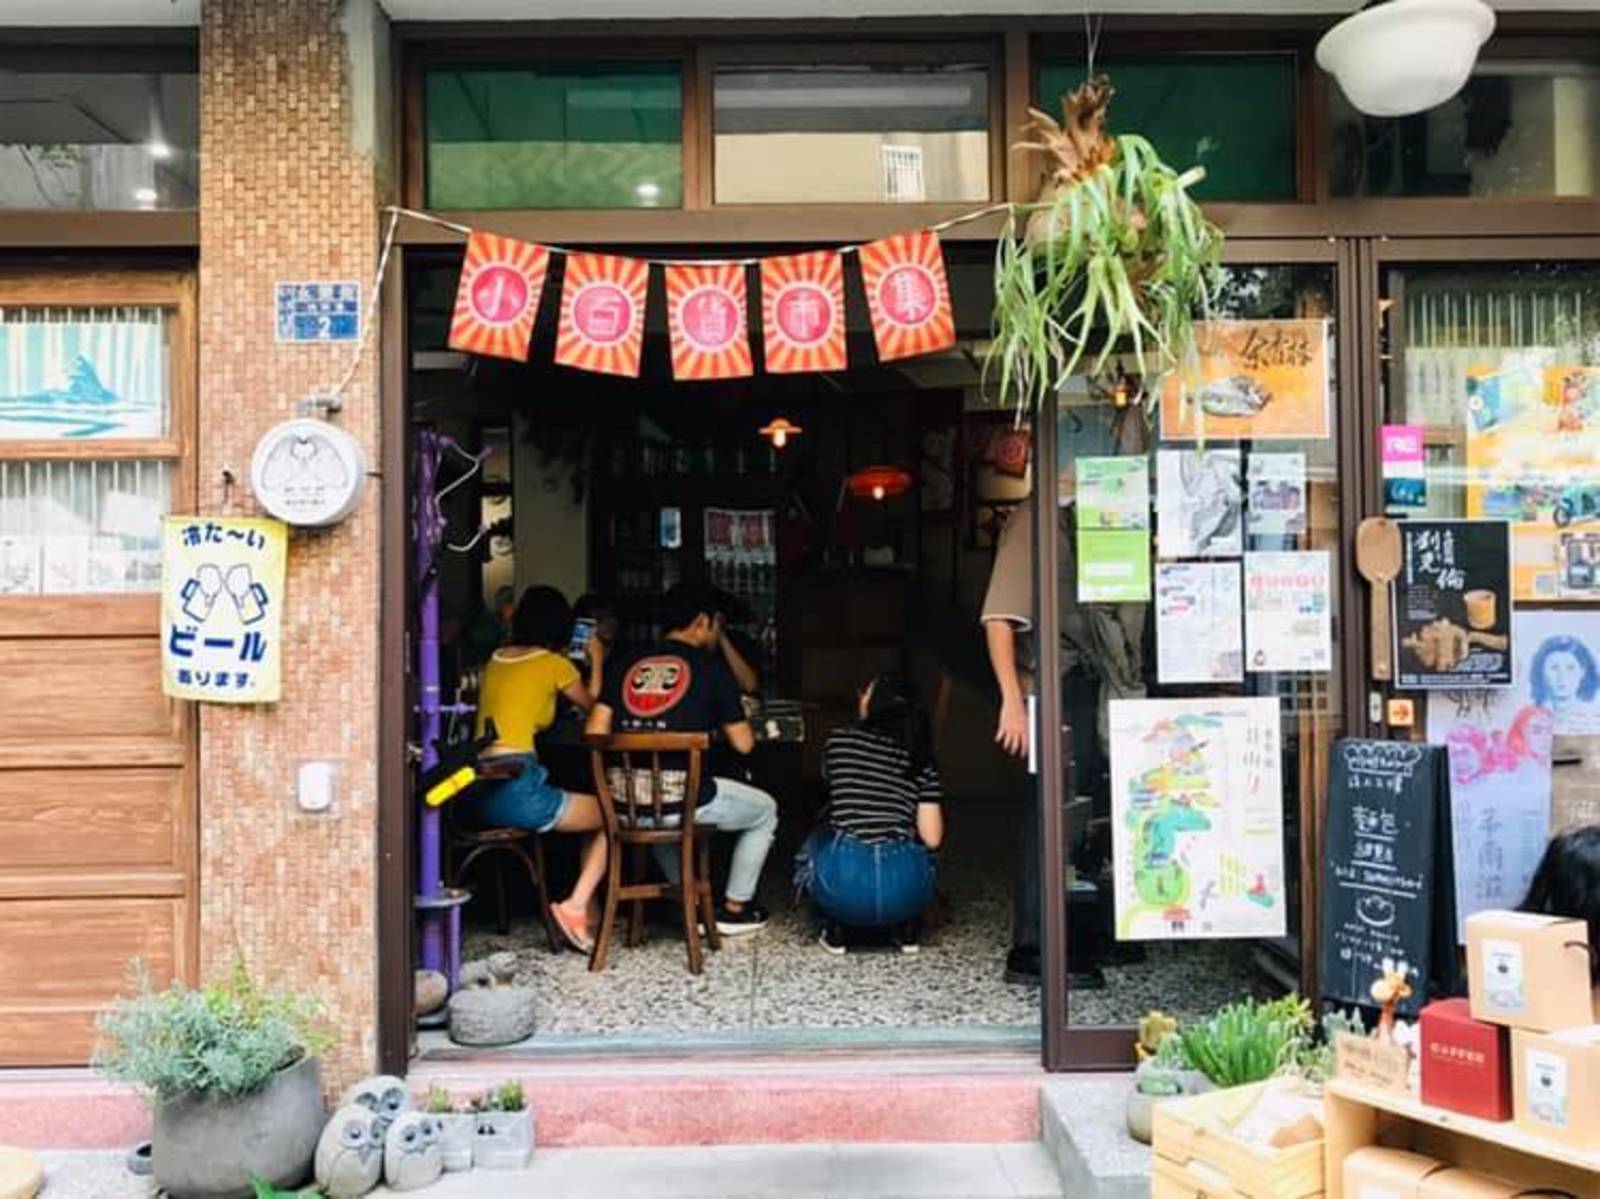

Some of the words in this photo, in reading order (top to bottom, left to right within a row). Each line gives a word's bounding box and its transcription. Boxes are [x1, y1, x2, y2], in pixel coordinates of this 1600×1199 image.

[317, 316, 332, 337] 2
[169, 624, 267, 662] ビール
